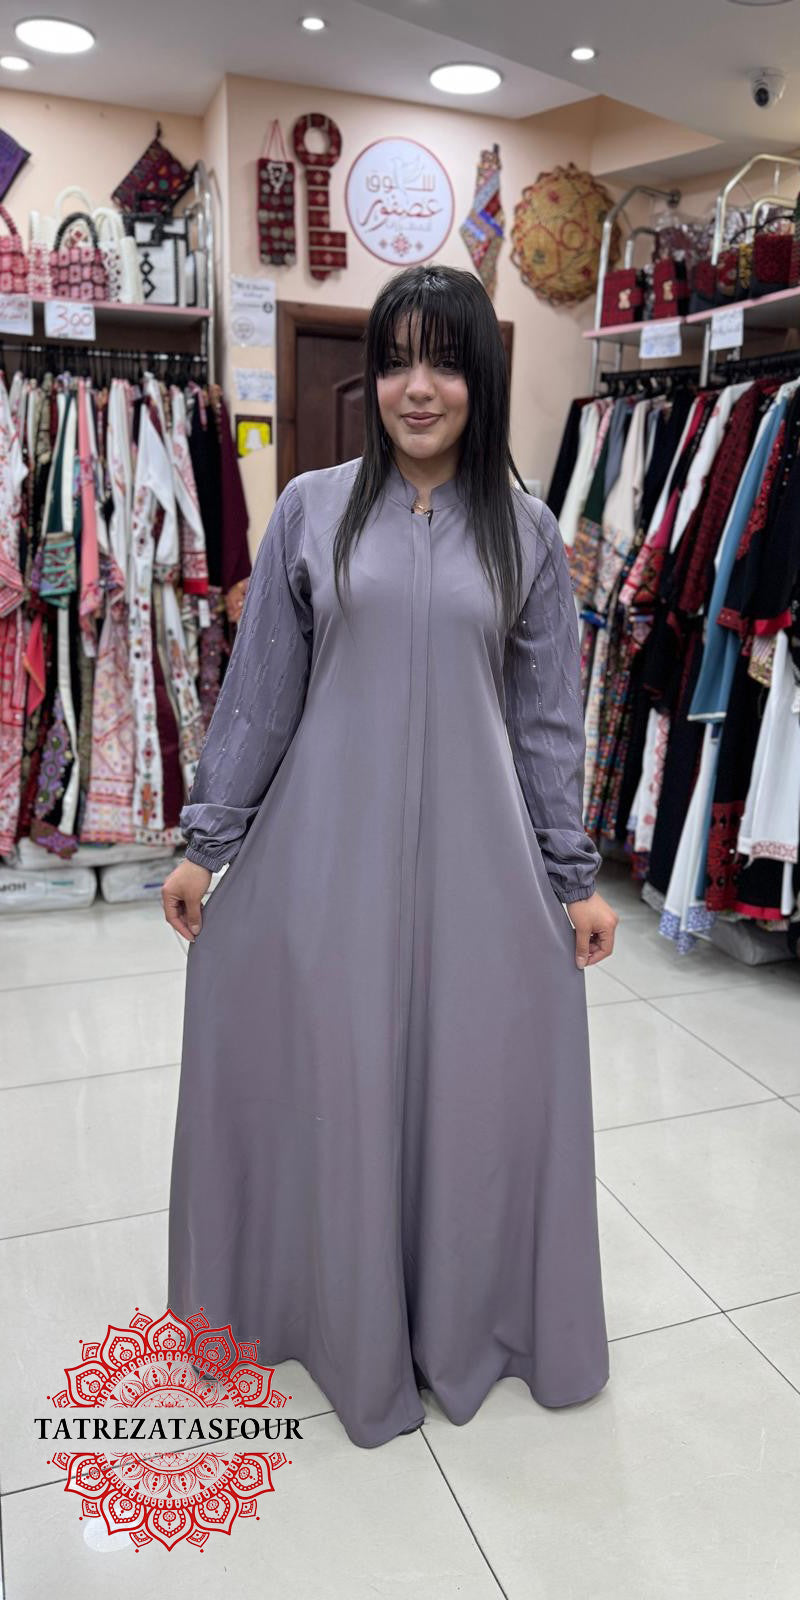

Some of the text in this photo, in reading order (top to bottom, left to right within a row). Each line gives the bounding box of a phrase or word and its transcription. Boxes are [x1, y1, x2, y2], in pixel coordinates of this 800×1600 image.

[365, 169, 436, 194] سوق
[356, 193, 443, 234] عصفور
[50, 304, 93, 334] 300
